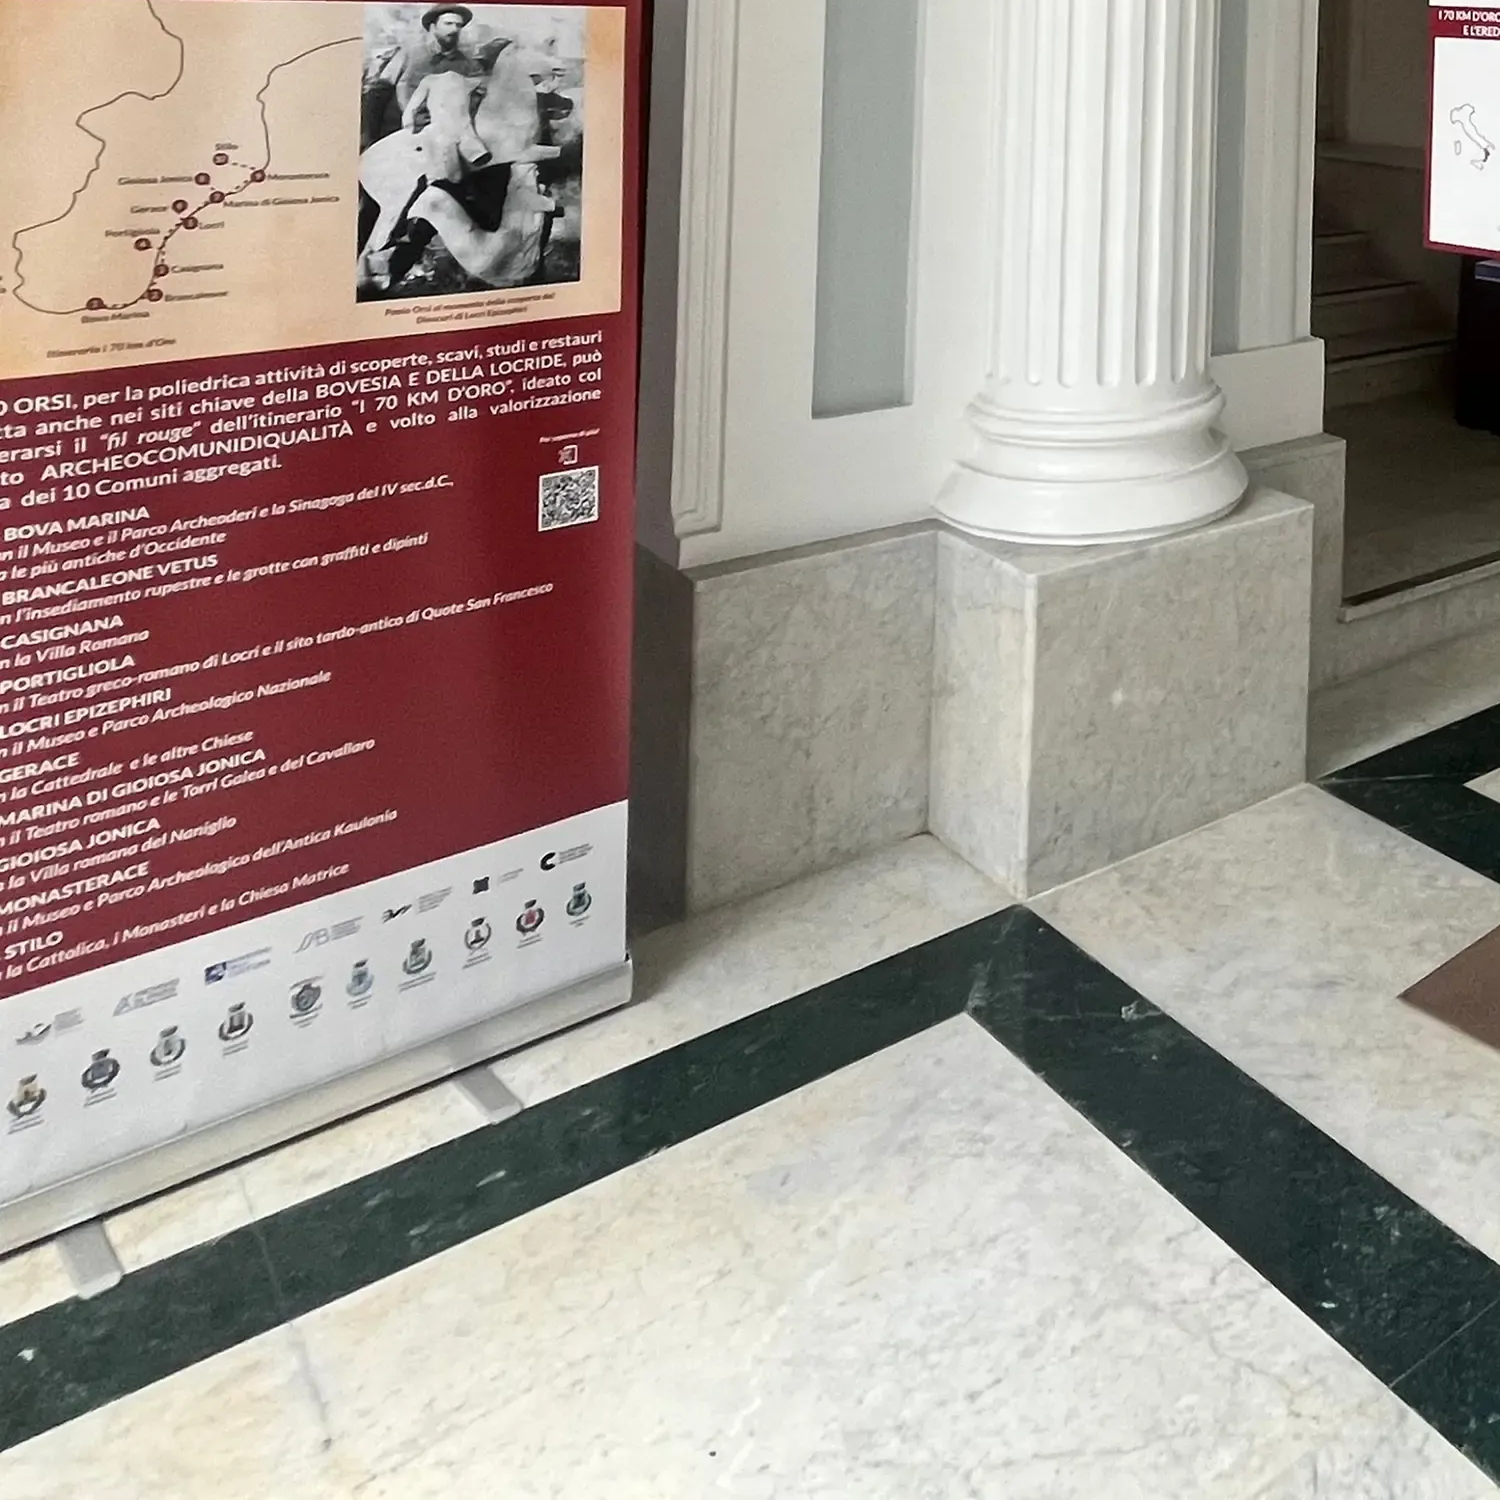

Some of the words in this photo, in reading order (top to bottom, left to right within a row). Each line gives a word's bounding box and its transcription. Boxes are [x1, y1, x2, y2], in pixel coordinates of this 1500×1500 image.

[1439, 10, 1442, 20] I
[1444, 10, 1454, 20] 70
[1456, 11, 1471, 20] KM
[1463, 25, 1469, 35] E
[14, 394, 77, 413] ORSI,
[84, 392, 120, 409] per
[126, 386, 143, 401] la
[149, 375, 250, 401] poliedrica
[255, 364, 325, 385] attività
[329, 361, 345, 375] di
[350, 354, 432, 373] scoperte,
[437, 345, 482, 363] scavi,
[487, 340, 525, 357] studi
[529, 342, 538, 351] e
[542, 330, 602, 349] restauri
[36, 415, 102, 435] anche
[111, 407, 142, 425] nei
[151, 402, 182, 420] siti
[190, 397, 255, 414] chiave
[262, 388, 308, 405] della
[316, 375, 401, 398] BOVESIA
[409, 372, 420, 386] E
[427, 365, 484, 384] DELLA
[491, 354, 566, 381] LOCRIDE,
[573, 350, 602, 370] può
[41, 420, 353, 481] ARCHEOCOMUNIDIQUALITÀ
[366, 422, 377, 432] e
[390, 413, 435, 428] volto
[448, 406, 477, 421] alla
[490, 390, 601, 414] valorizzazione
[75, 437, 86, 453] il
[210, 405, 341, 433] dell'itinerario
[375, 395, 397, 410] 70
[408, 390, 438, 406] KM
[523, 375, 571, 390] ideato
[579, 368, 601, 382] col
[21, 488, 55, 506] dei
[64, 483, 90, 501] 10
[95, 468, 177, 491] Comuni
[183, 454, 282, 482] aggregati.
[4, 521, 63, 541] BOVA
[67, 507, 149, 531] MARINA
[2, 566, 153, 605] BRANCALEONE
[157, 555, 218, 576] VETUS
[0, 615, 123, 649] CASIGNANA
[0, 655, 135, 694] PORTIGLIOLA
[0, 714, 59, 739] LOCRI
[64, 688, 171, 724] EPIZEPHIRI
[0, 752, 79, 783] GERACE
[0, 796, 82, 826] MARINA
[87, 788, 107, 805] DI
[112, 767, 193, 797] GIOIOSA
[197, 749, 265, 776] JONICA
[0, 839, 82, 872] GIOIOSA
[87, 818, 160, 848] JONICA
[0, 861, 148, 915] MONASTERACE
[5, 931, 63, 959] STILO
[6, 965, 22, 979] la
[27, 939, 109, 972] Cattolica,
[112, 932, 119, 945] i
[122, 906, 205, 942] Monasteri
[208, 905, 218, 915] e
[220, 899, 235, 912] la
[238, 883, 289, 905] Chiesa
[292, 864, 349, 889] Matrice
